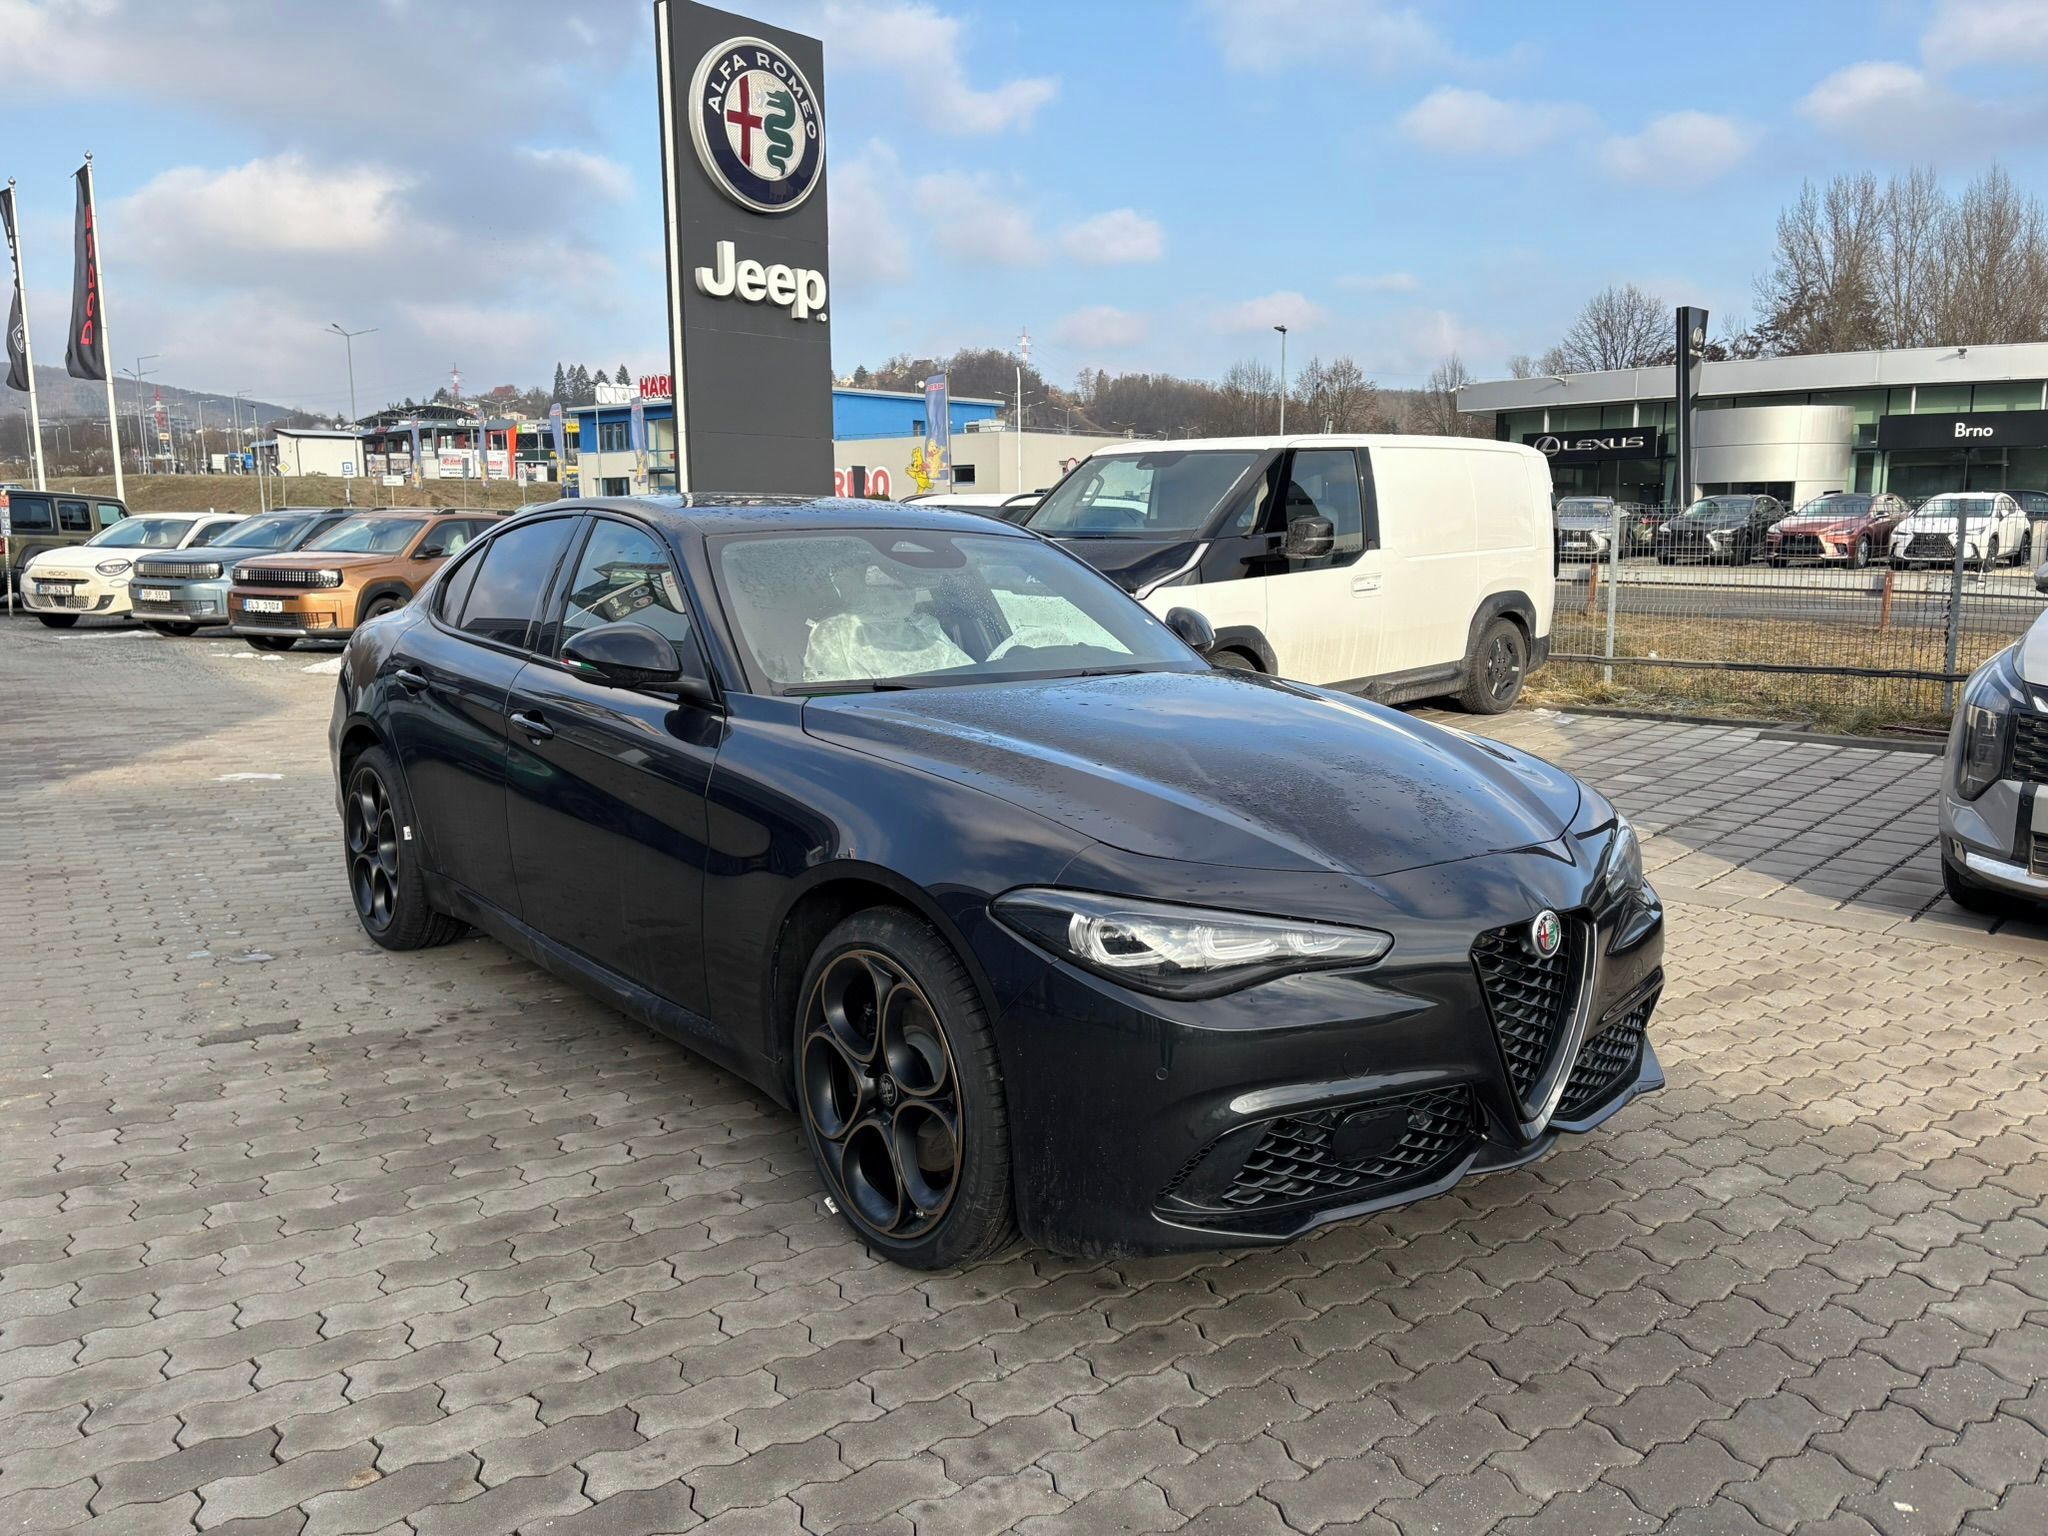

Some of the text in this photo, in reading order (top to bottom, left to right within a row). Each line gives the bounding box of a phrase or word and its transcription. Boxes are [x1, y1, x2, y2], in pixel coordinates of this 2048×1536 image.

[708, 51, 817, 139] ALFA ROMEO
[695, 240, 827, 319] Jeep
[1563, 436, 1644, 452] LEXUS
[1954, 422, 1994, 438] Brno
